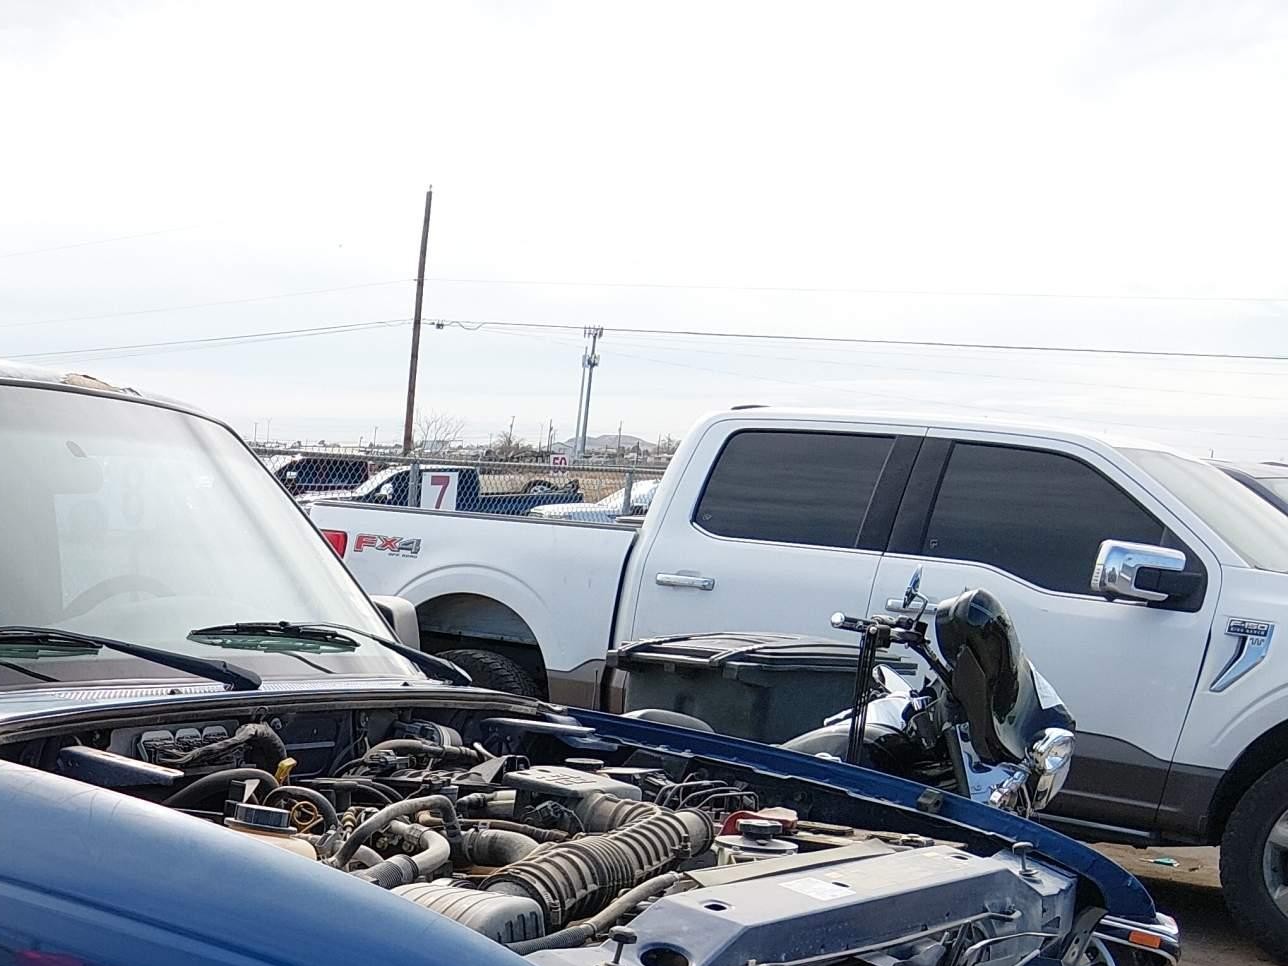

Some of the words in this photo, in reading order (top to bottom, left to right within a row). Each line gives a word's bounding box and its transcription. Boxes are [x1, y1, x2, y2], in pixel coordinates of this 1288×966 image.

[430, 475, 451, 509] 7
[353, 533, 422, 554] FX4
[1230, 620, 1269, 630] F-150
